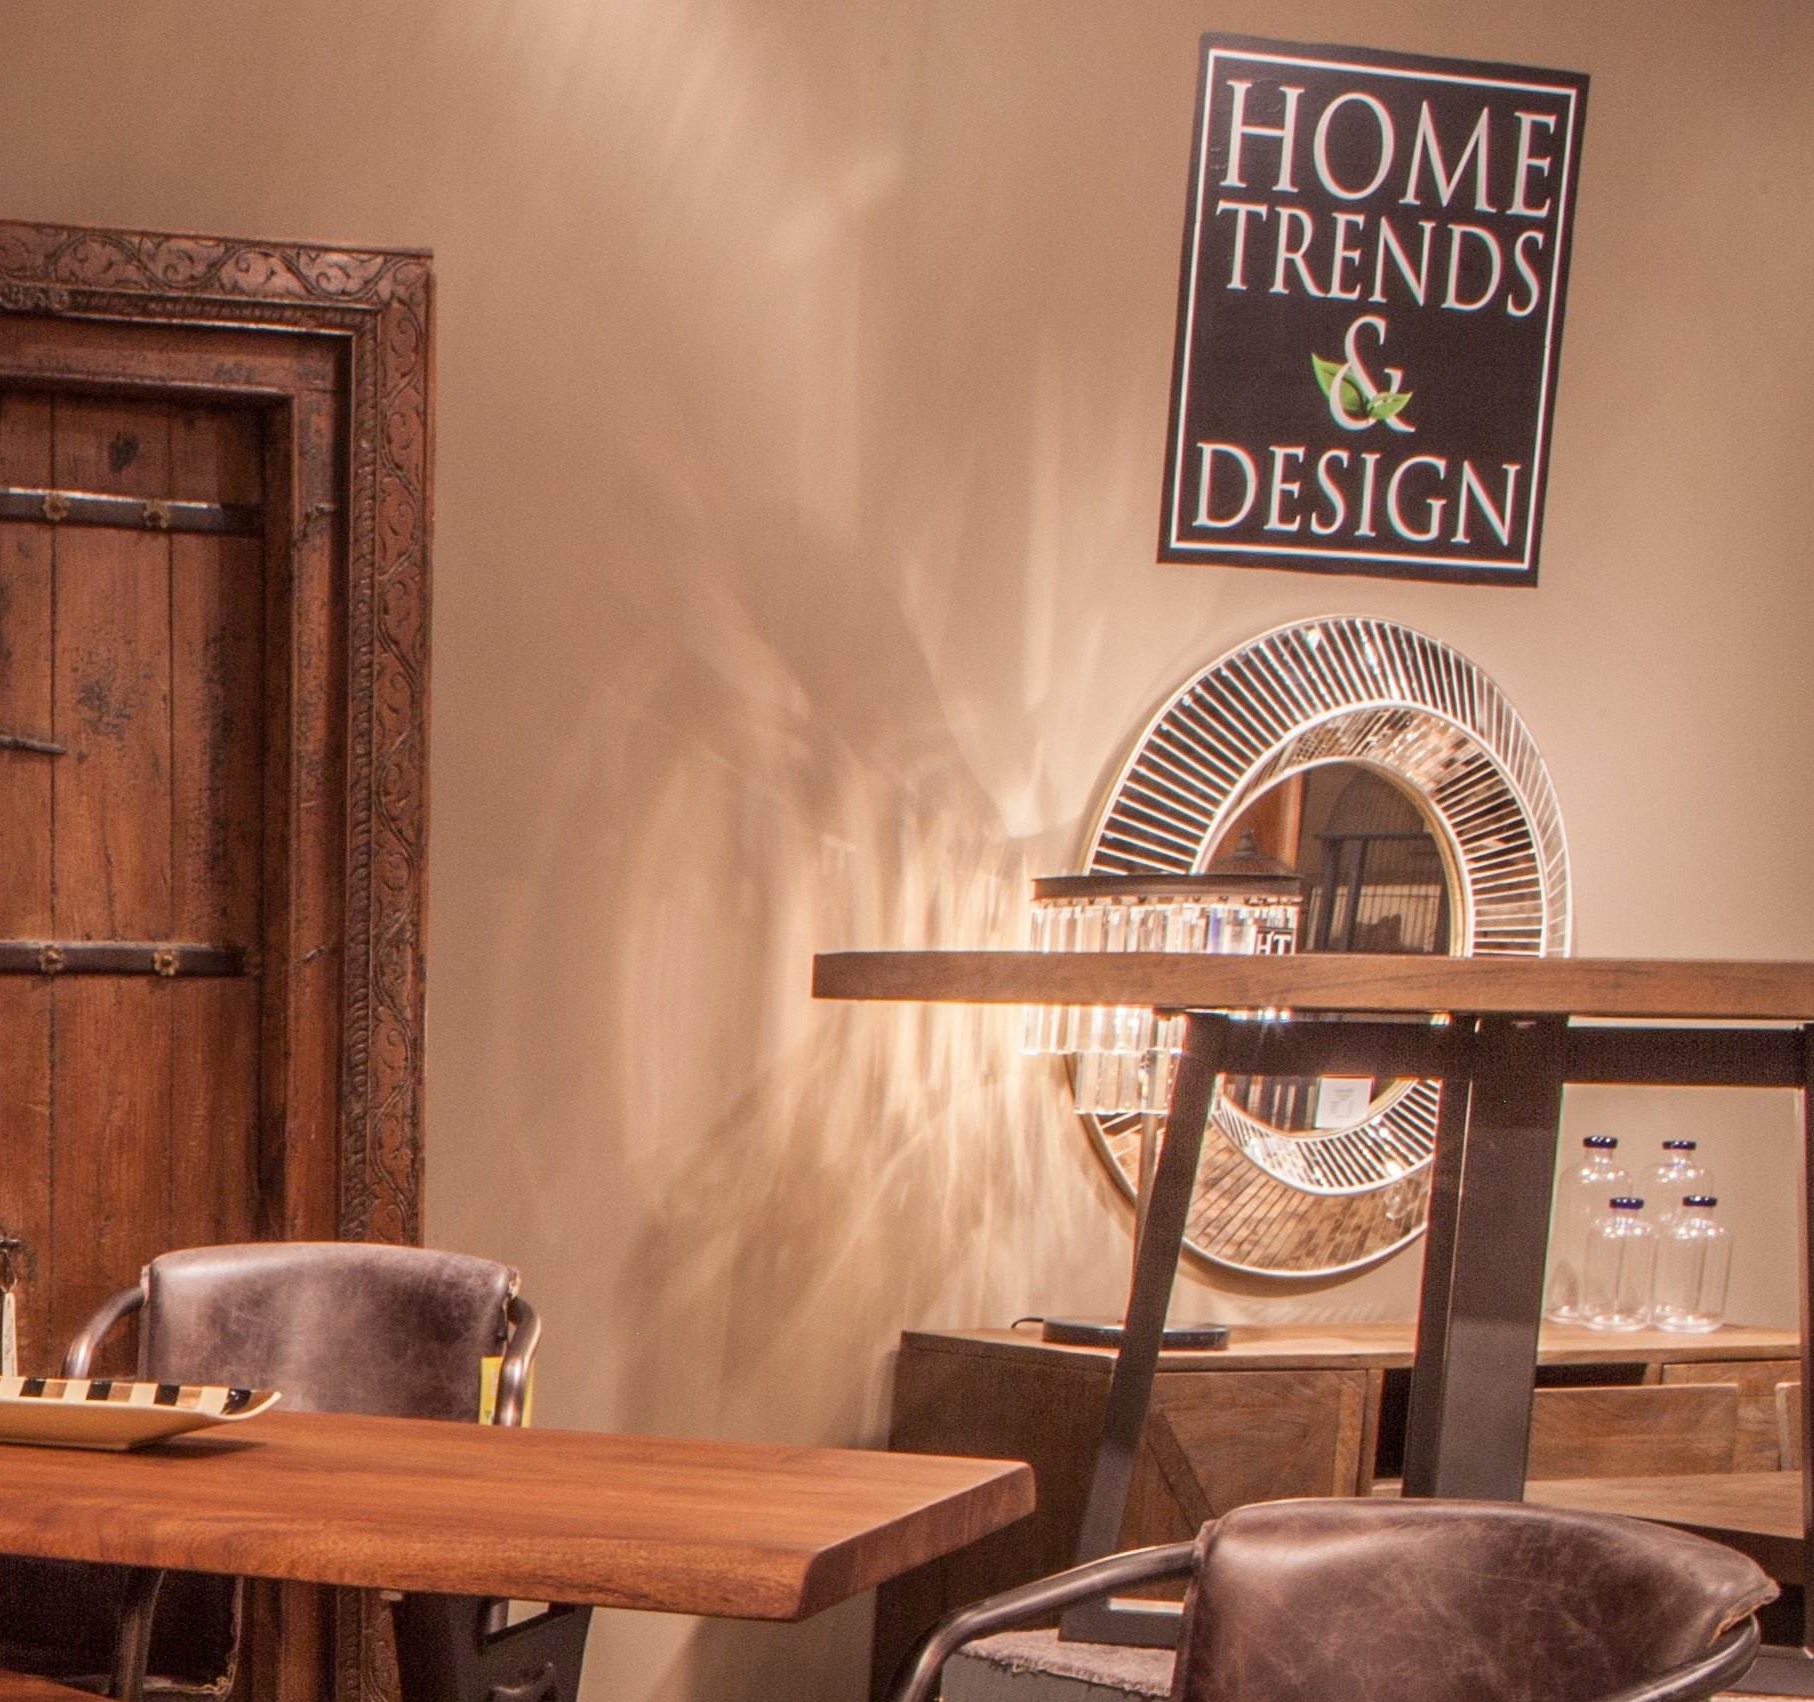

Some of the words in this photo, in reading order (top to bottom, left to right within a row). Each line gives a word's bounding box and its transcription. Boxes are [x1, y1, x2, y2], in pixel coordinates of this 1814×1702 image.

[1219, 79, 1557, 219] HOME
[1216, 200, 1544, 317] TRENDS
[1329, 316, 1416, 432] &
[1192, 442, 1521, 546] DESIGN
